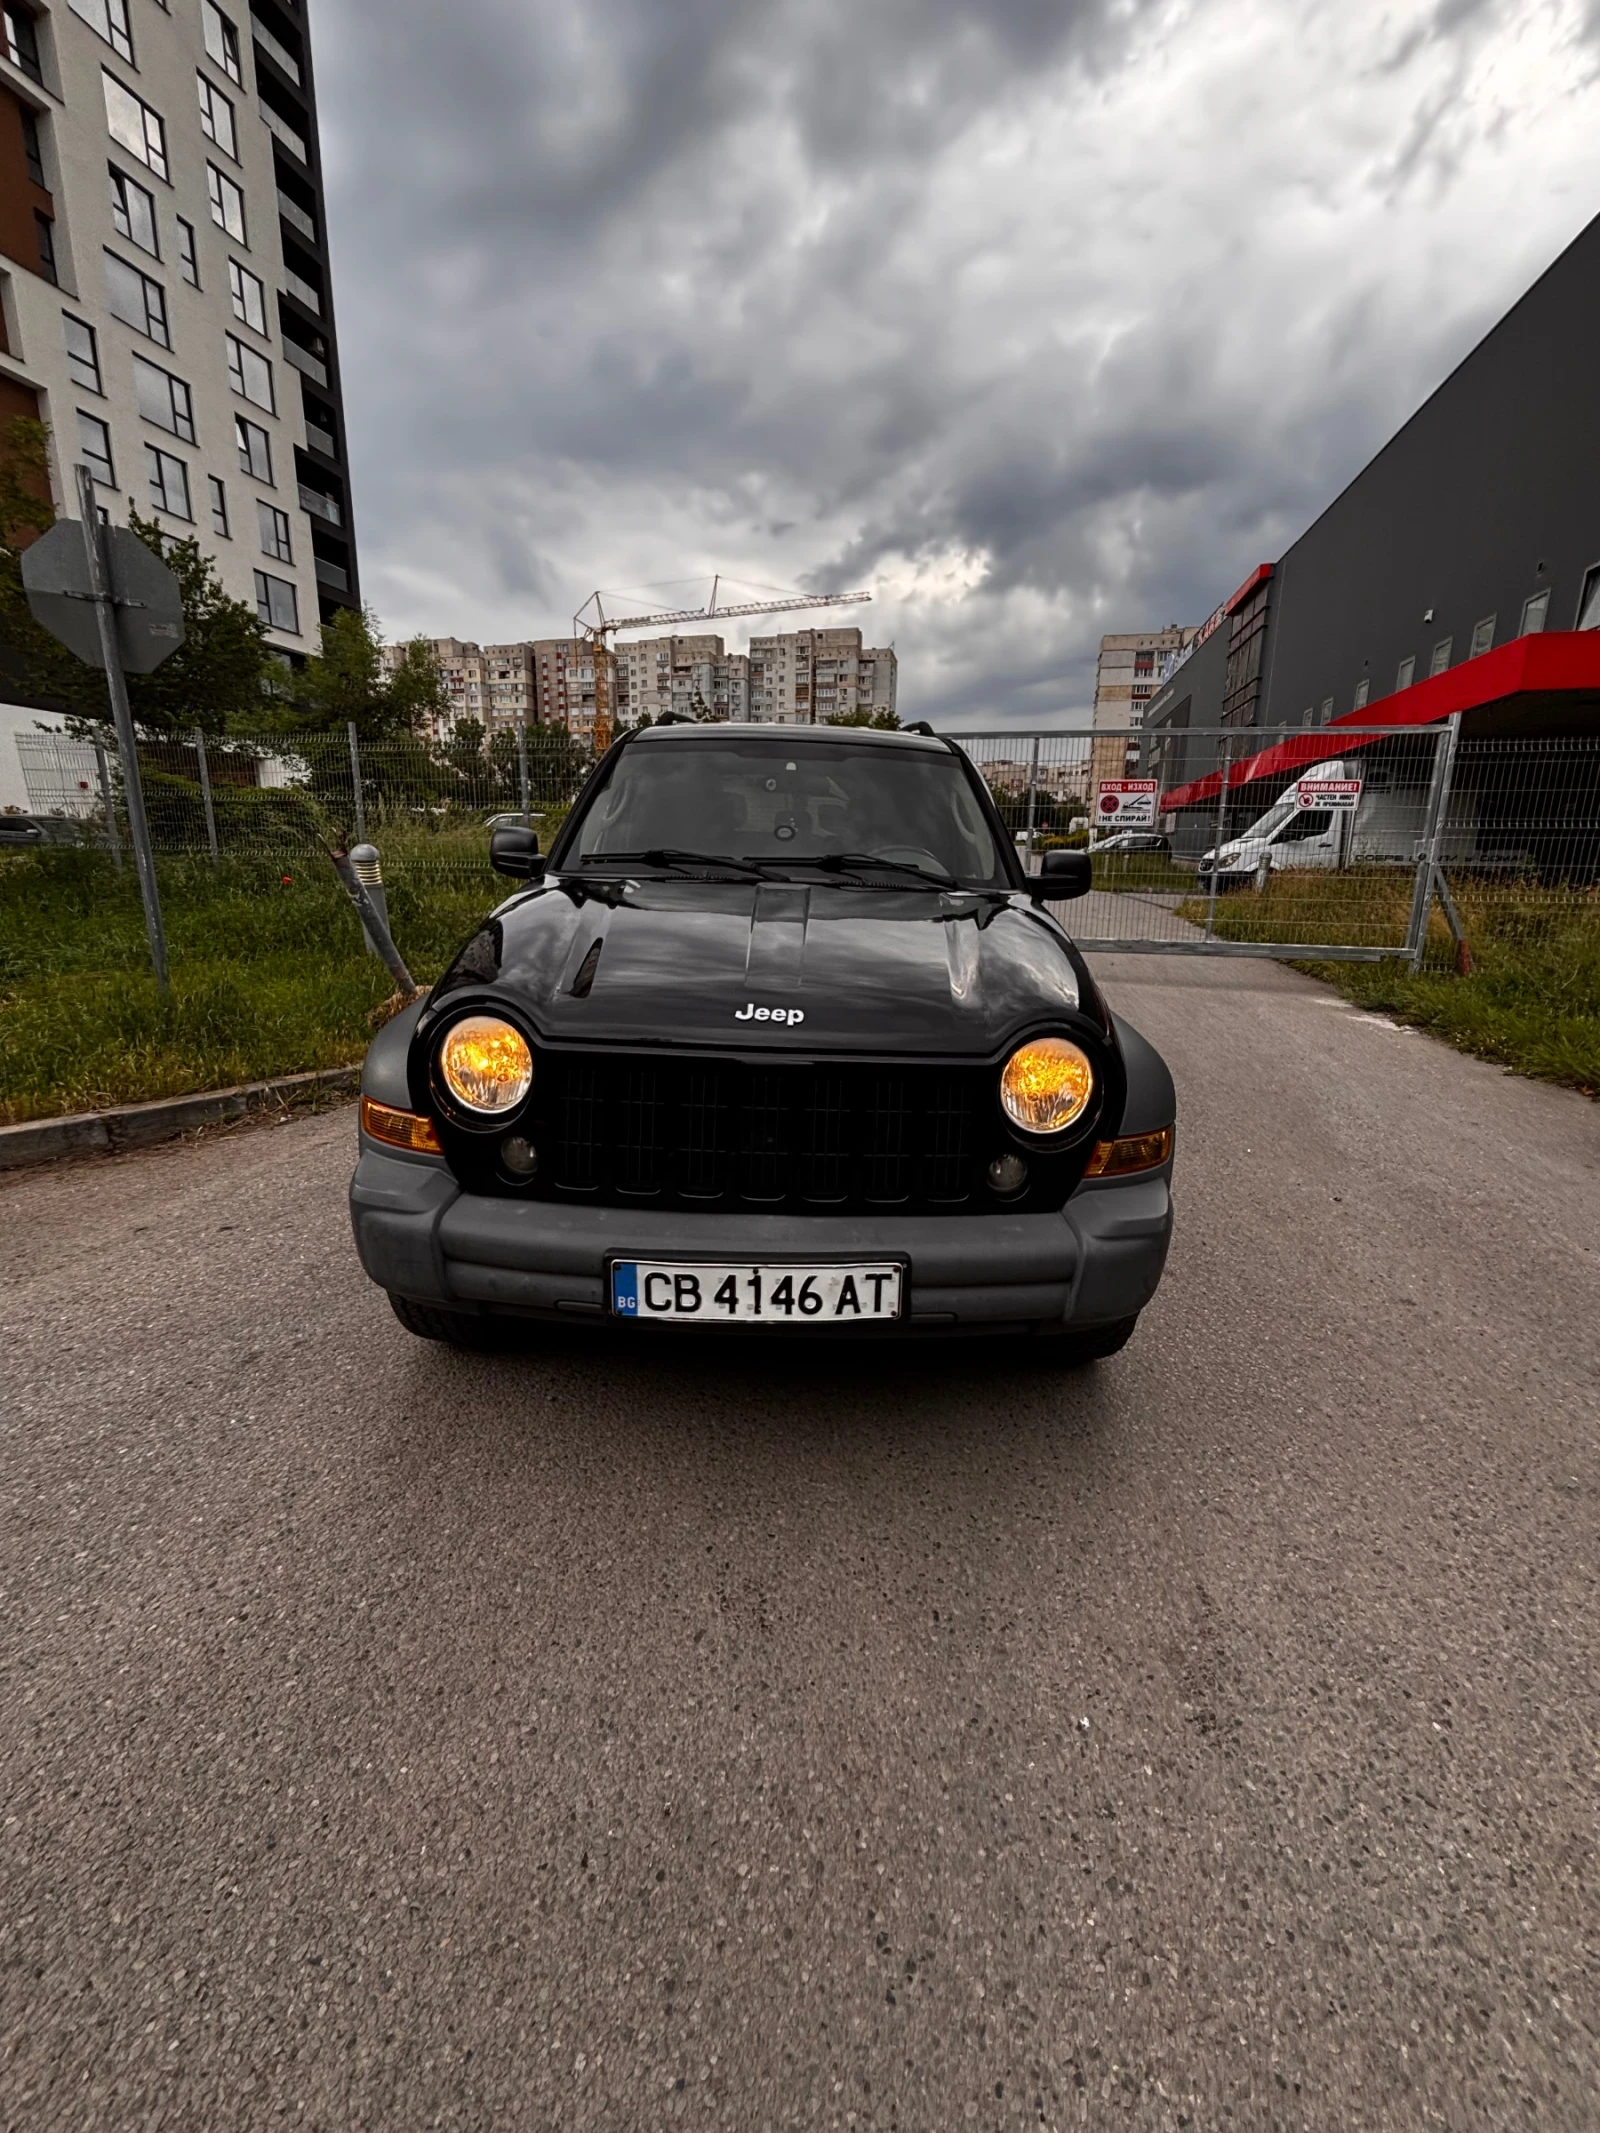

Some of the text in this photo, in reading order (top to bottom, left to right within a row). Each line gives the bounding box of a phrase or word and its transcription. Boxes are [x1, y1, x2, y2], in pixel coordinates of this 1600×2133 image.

[1101, 783, 1122, 792] ВХОД
[1127, 783, 1154, 791] ИЗХОД
[1301, 782, 1358, 791] ВНИМАНИЕ!
[734, 1003, 805, 1026] Jeep
[644, 1272, 893, 1316] CB 4146 AT
[618, 1296, 636, 1309] BG
